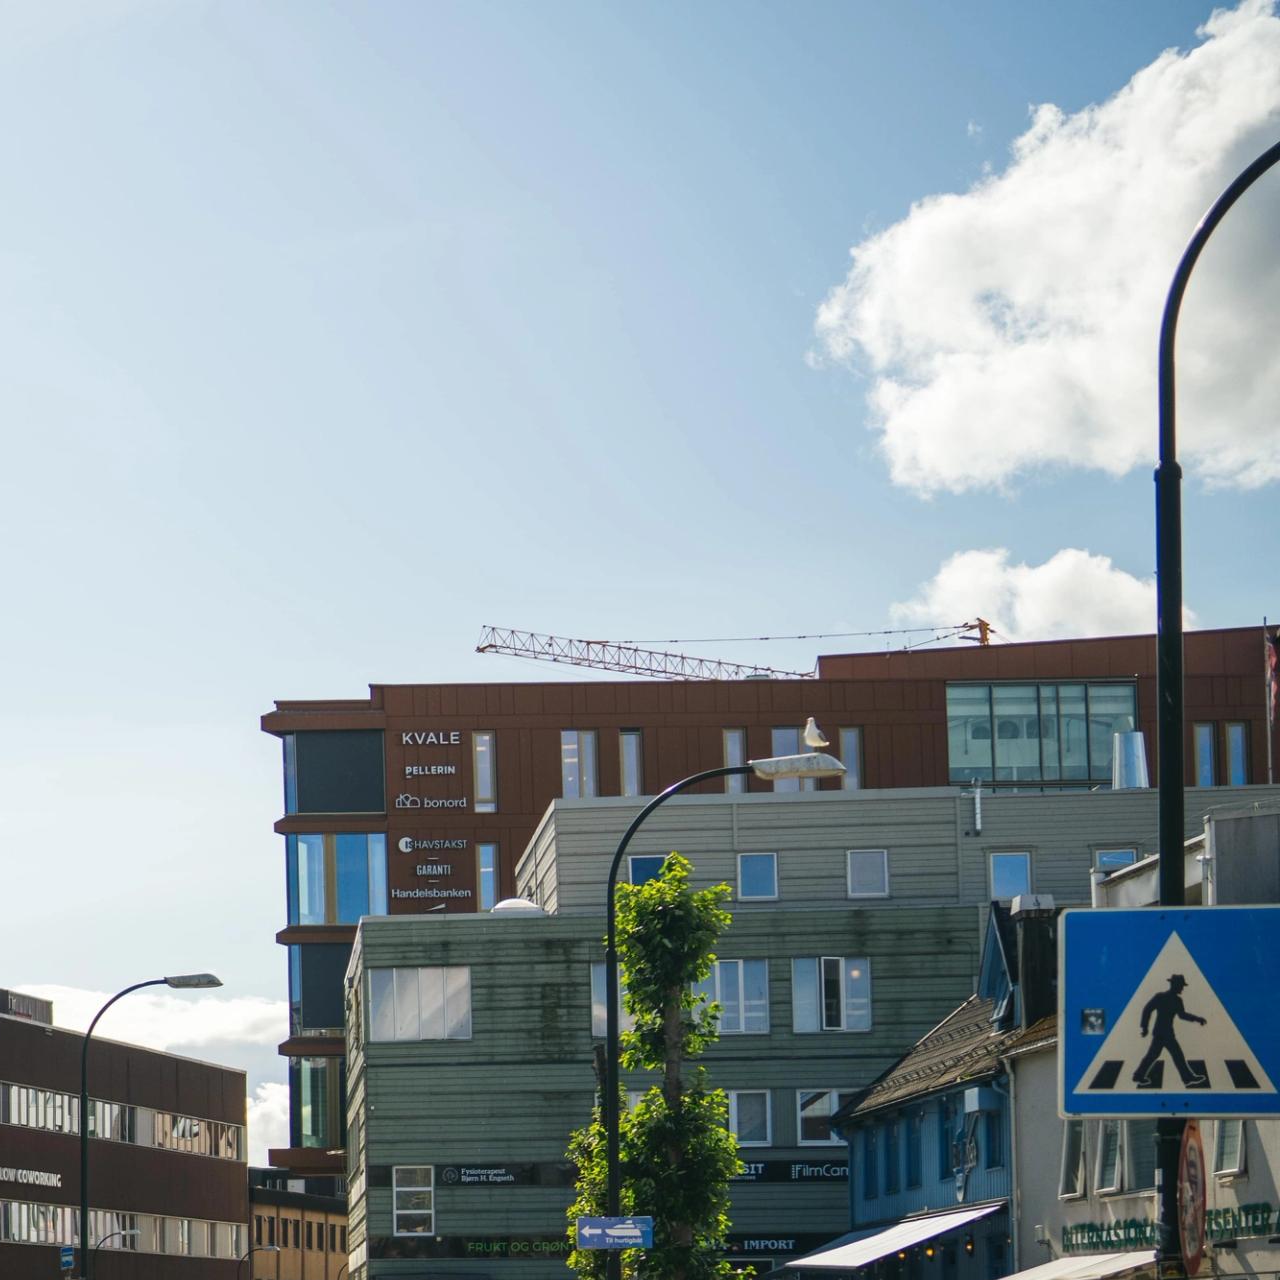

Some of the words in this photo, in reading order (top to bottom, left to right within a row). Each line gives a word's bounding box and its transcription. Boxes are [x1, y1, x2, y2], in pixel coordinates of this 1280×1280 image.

[402, 732, 460, 745] KVALE
[405, 766, 456, 777] PELLERIN
[424, 797, 467, 808] bonord
[405, 839, 468, 849] ISHAVSTAKST
[416, 865, 452, 876] GARANTI
[391, 888, 472, 898] Handelsbanken
[18, 1170, 62, 1187] COWORKING
[467, 1241, 508, 1253] FRUKT
[510, 1241, 530, 1253] OG
[532, 1240, 570, 1253] GRØN
[744, 1239, 796, 1250] IMPORT
